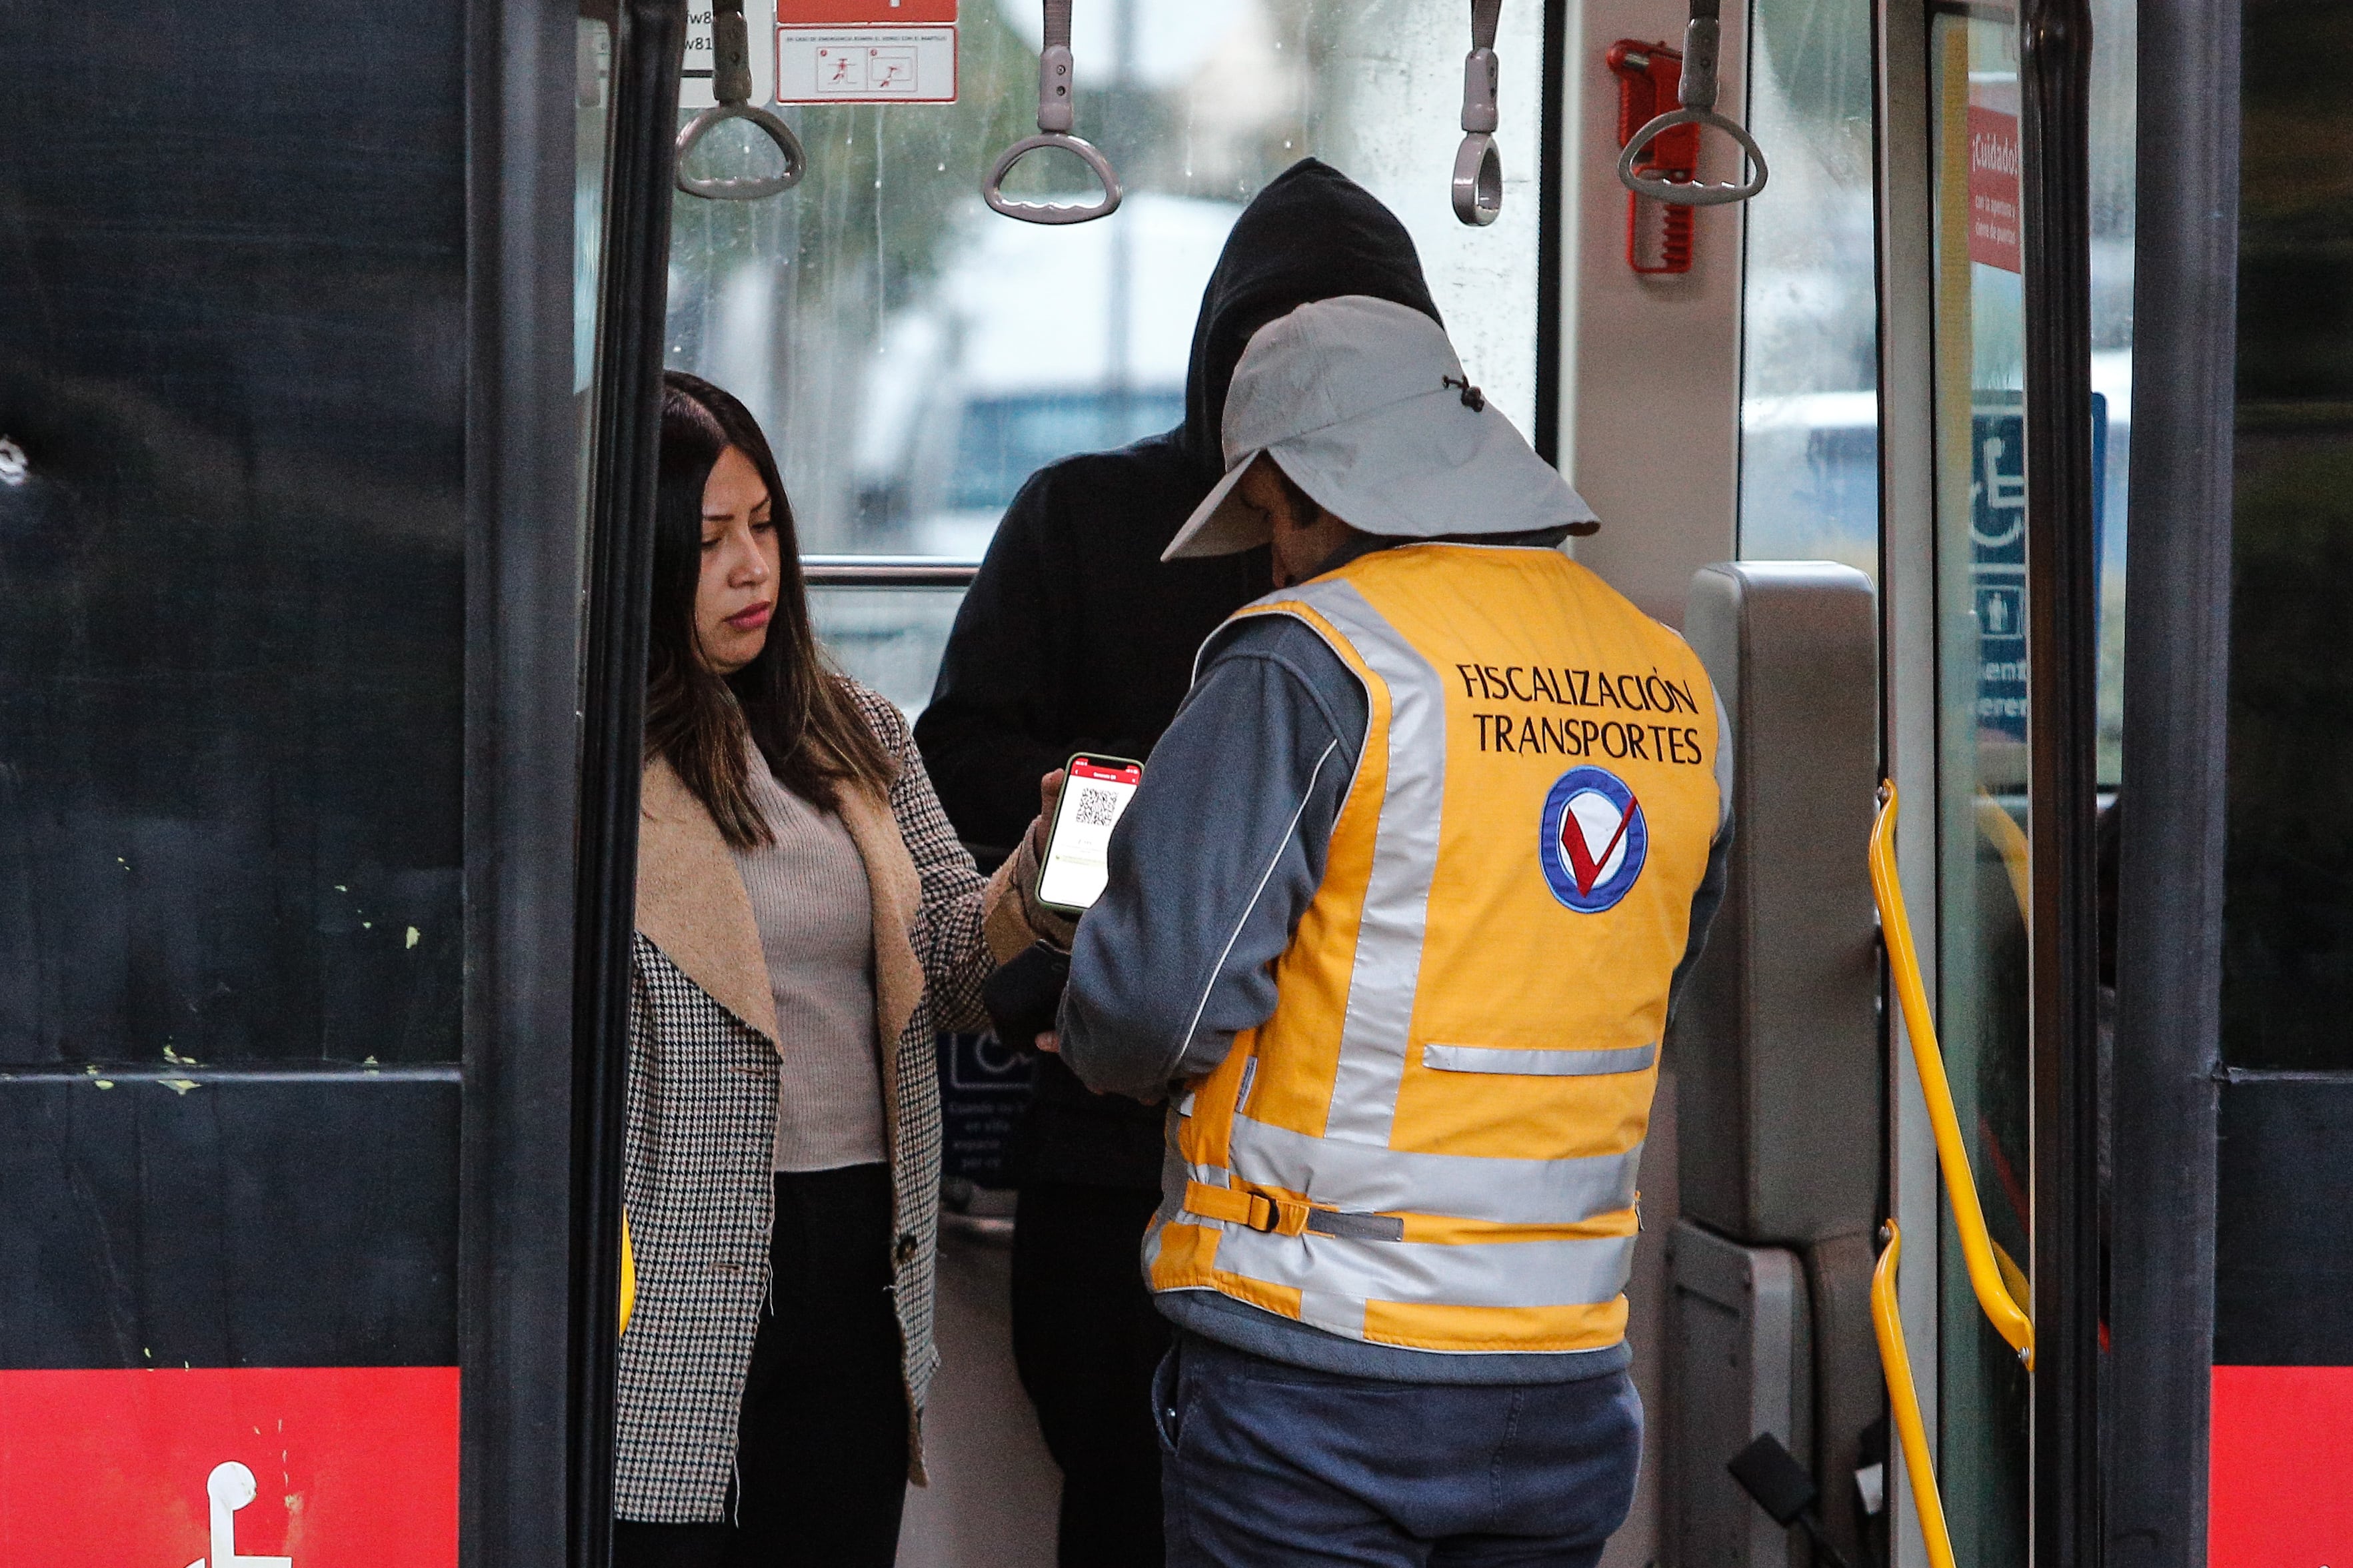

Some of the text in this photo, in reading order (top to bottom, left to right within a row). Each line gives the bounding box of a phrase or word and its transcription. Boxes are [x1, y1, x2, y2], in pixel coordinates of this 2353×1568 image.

[686, 9, 711, 24] w8
[1972, 133, 2017, 176] ¡Cuidado!
[1456, 664, 1699, 714] FISCALIZACIÓN
[1473, 714, 1702, 764] TRANSPORTES
